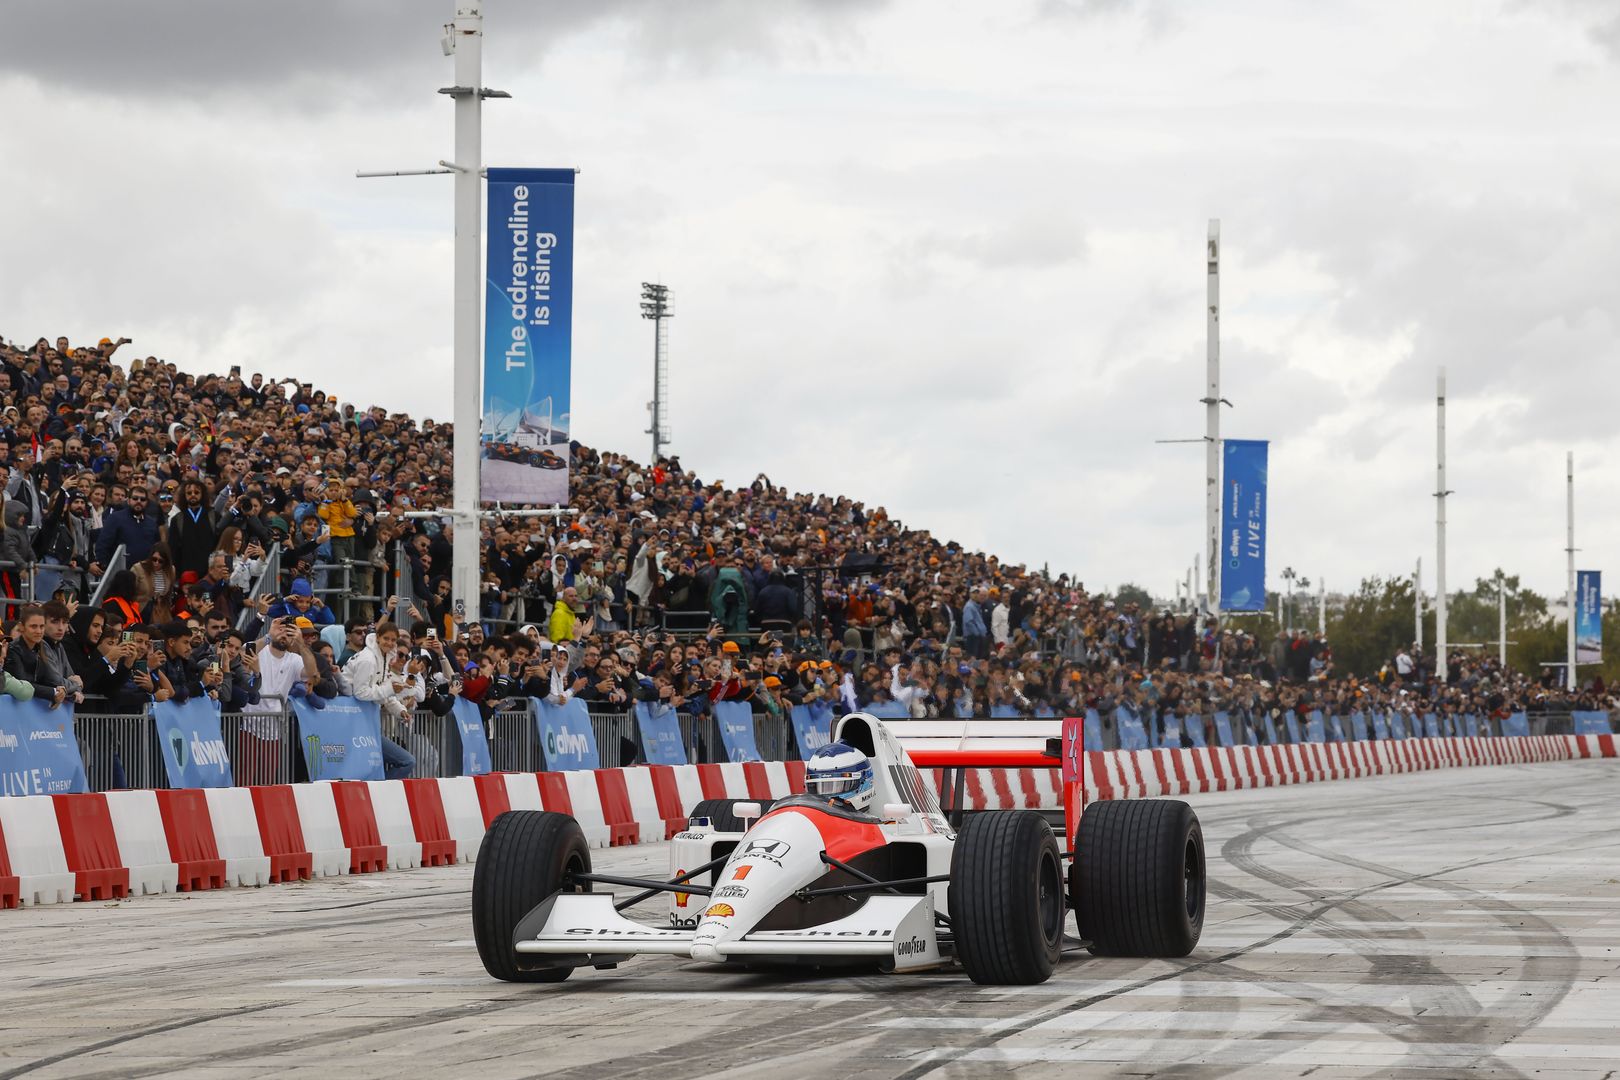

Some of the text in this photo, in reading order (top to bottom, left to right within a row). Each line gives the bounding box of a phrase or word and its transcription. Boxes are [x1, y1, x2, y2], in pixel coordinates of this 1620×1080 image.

[505, 185, 529, 371] The adrenaline
[530, 232, 557, 326] is rising
[1230, 529, 1240, 557] allwyn
[1248, 520, 1260, 558] LIVE
[0, 729, 63, 752] llwyn McLaren
[191, 730, 230, 774] allwyn
[556, 726, 589, 762] allwyn
[3, 769, 43, 797] LIVE
[43, 767, 52, 777] IN
[732, 865, 753, 880] 1
[670, 913, 701, 926] Shel
[897, 936, 926, 958] GOODYEAR
